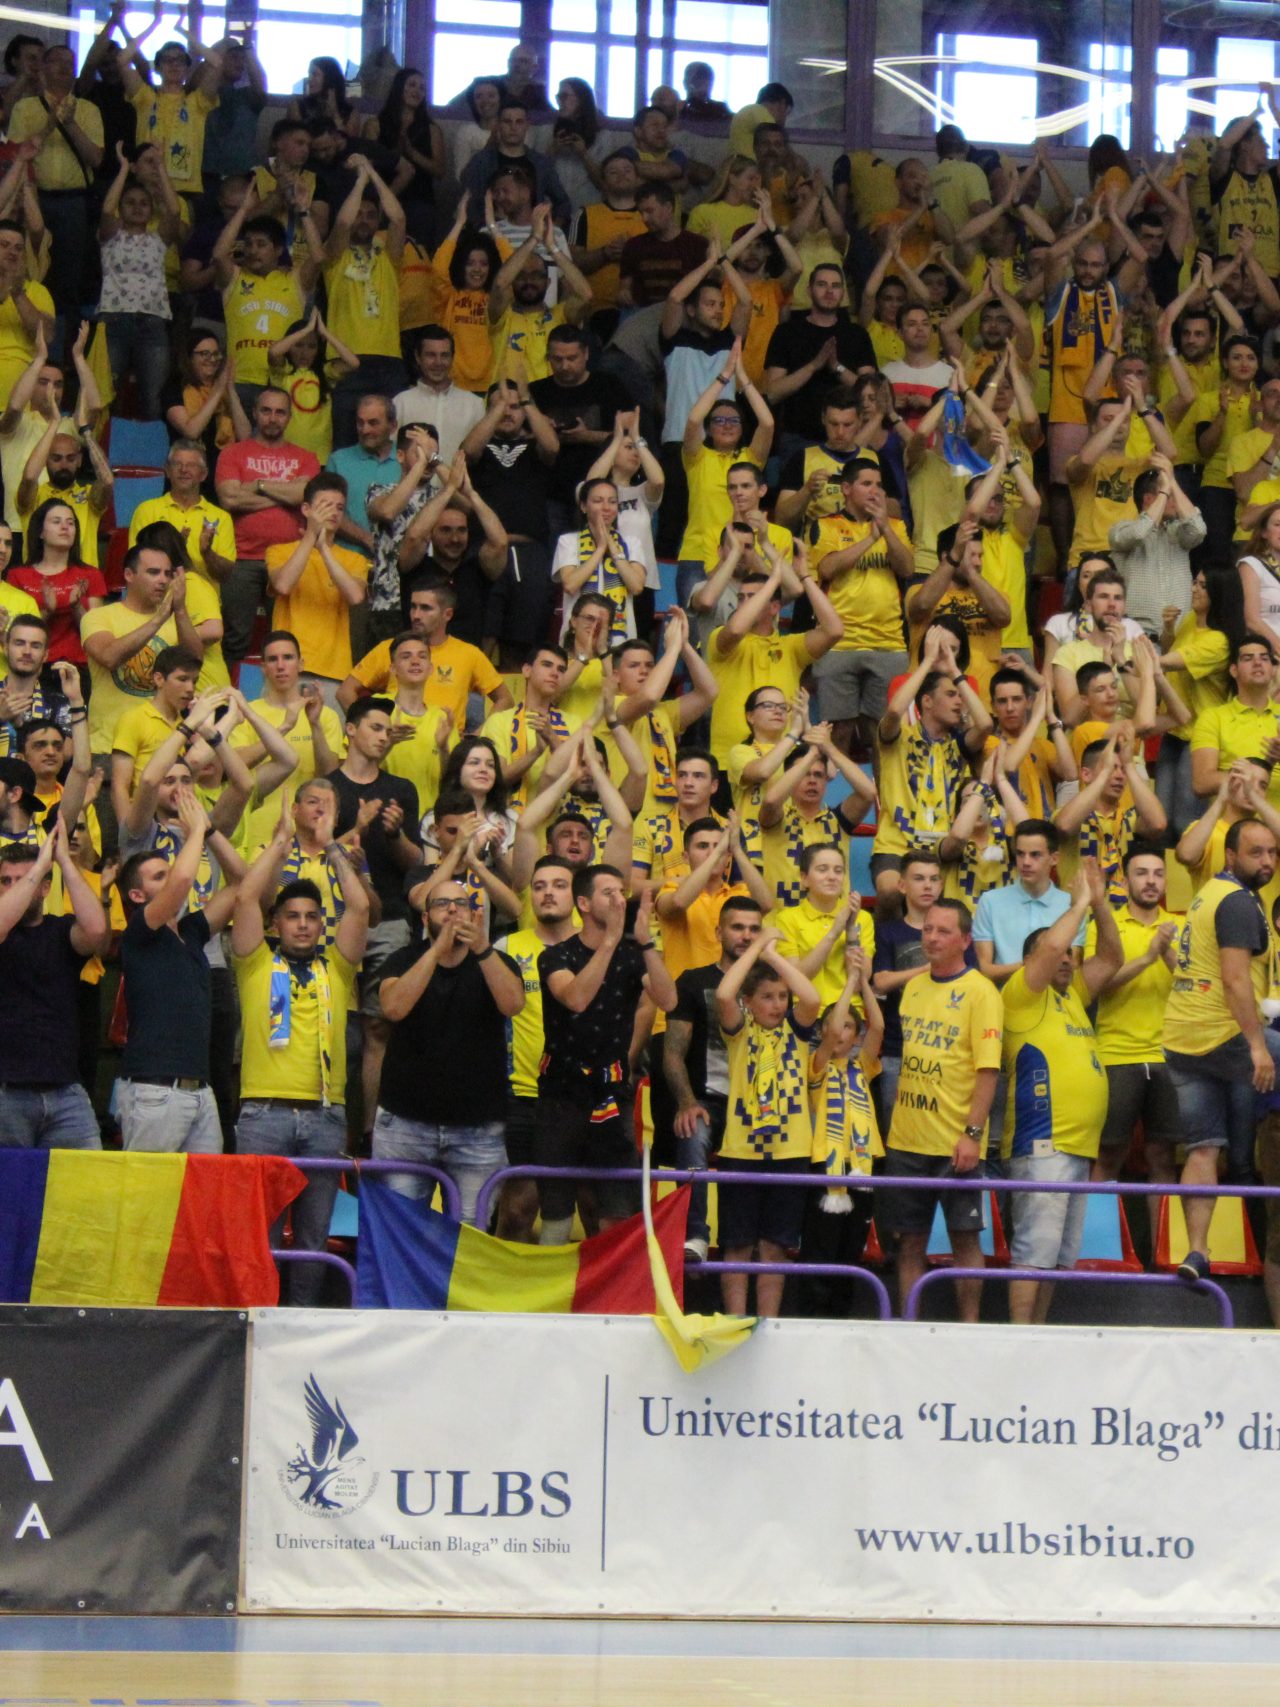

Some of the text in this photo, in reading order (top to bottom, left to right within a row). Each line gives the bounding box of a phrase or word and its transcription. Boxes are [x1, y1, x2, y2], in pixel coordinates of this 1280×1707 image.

[256, 314, 269, 334] 4
[914, 1017, 943, 1033] PLAY
[947, 1024, 960, 1037] IS
[914, 1030, 954, 1052] PLAY
[903, 1055, 943, 1077] AQUA
[899, 1090, 939, 1113] VISMA
[639, 1396, 904, 1441] Universitatea
[391, 1469, 572, 1519] ULBS
[15, 1503, 51, 1539] A
[275, 1533, 376, 1551] Universitatea
[503, 1537, 528, 1553] din
[532, 1537, 571, 1554] Sibiu
[854, 1521, 1195, 1560] www.ulbsibiu.ro
